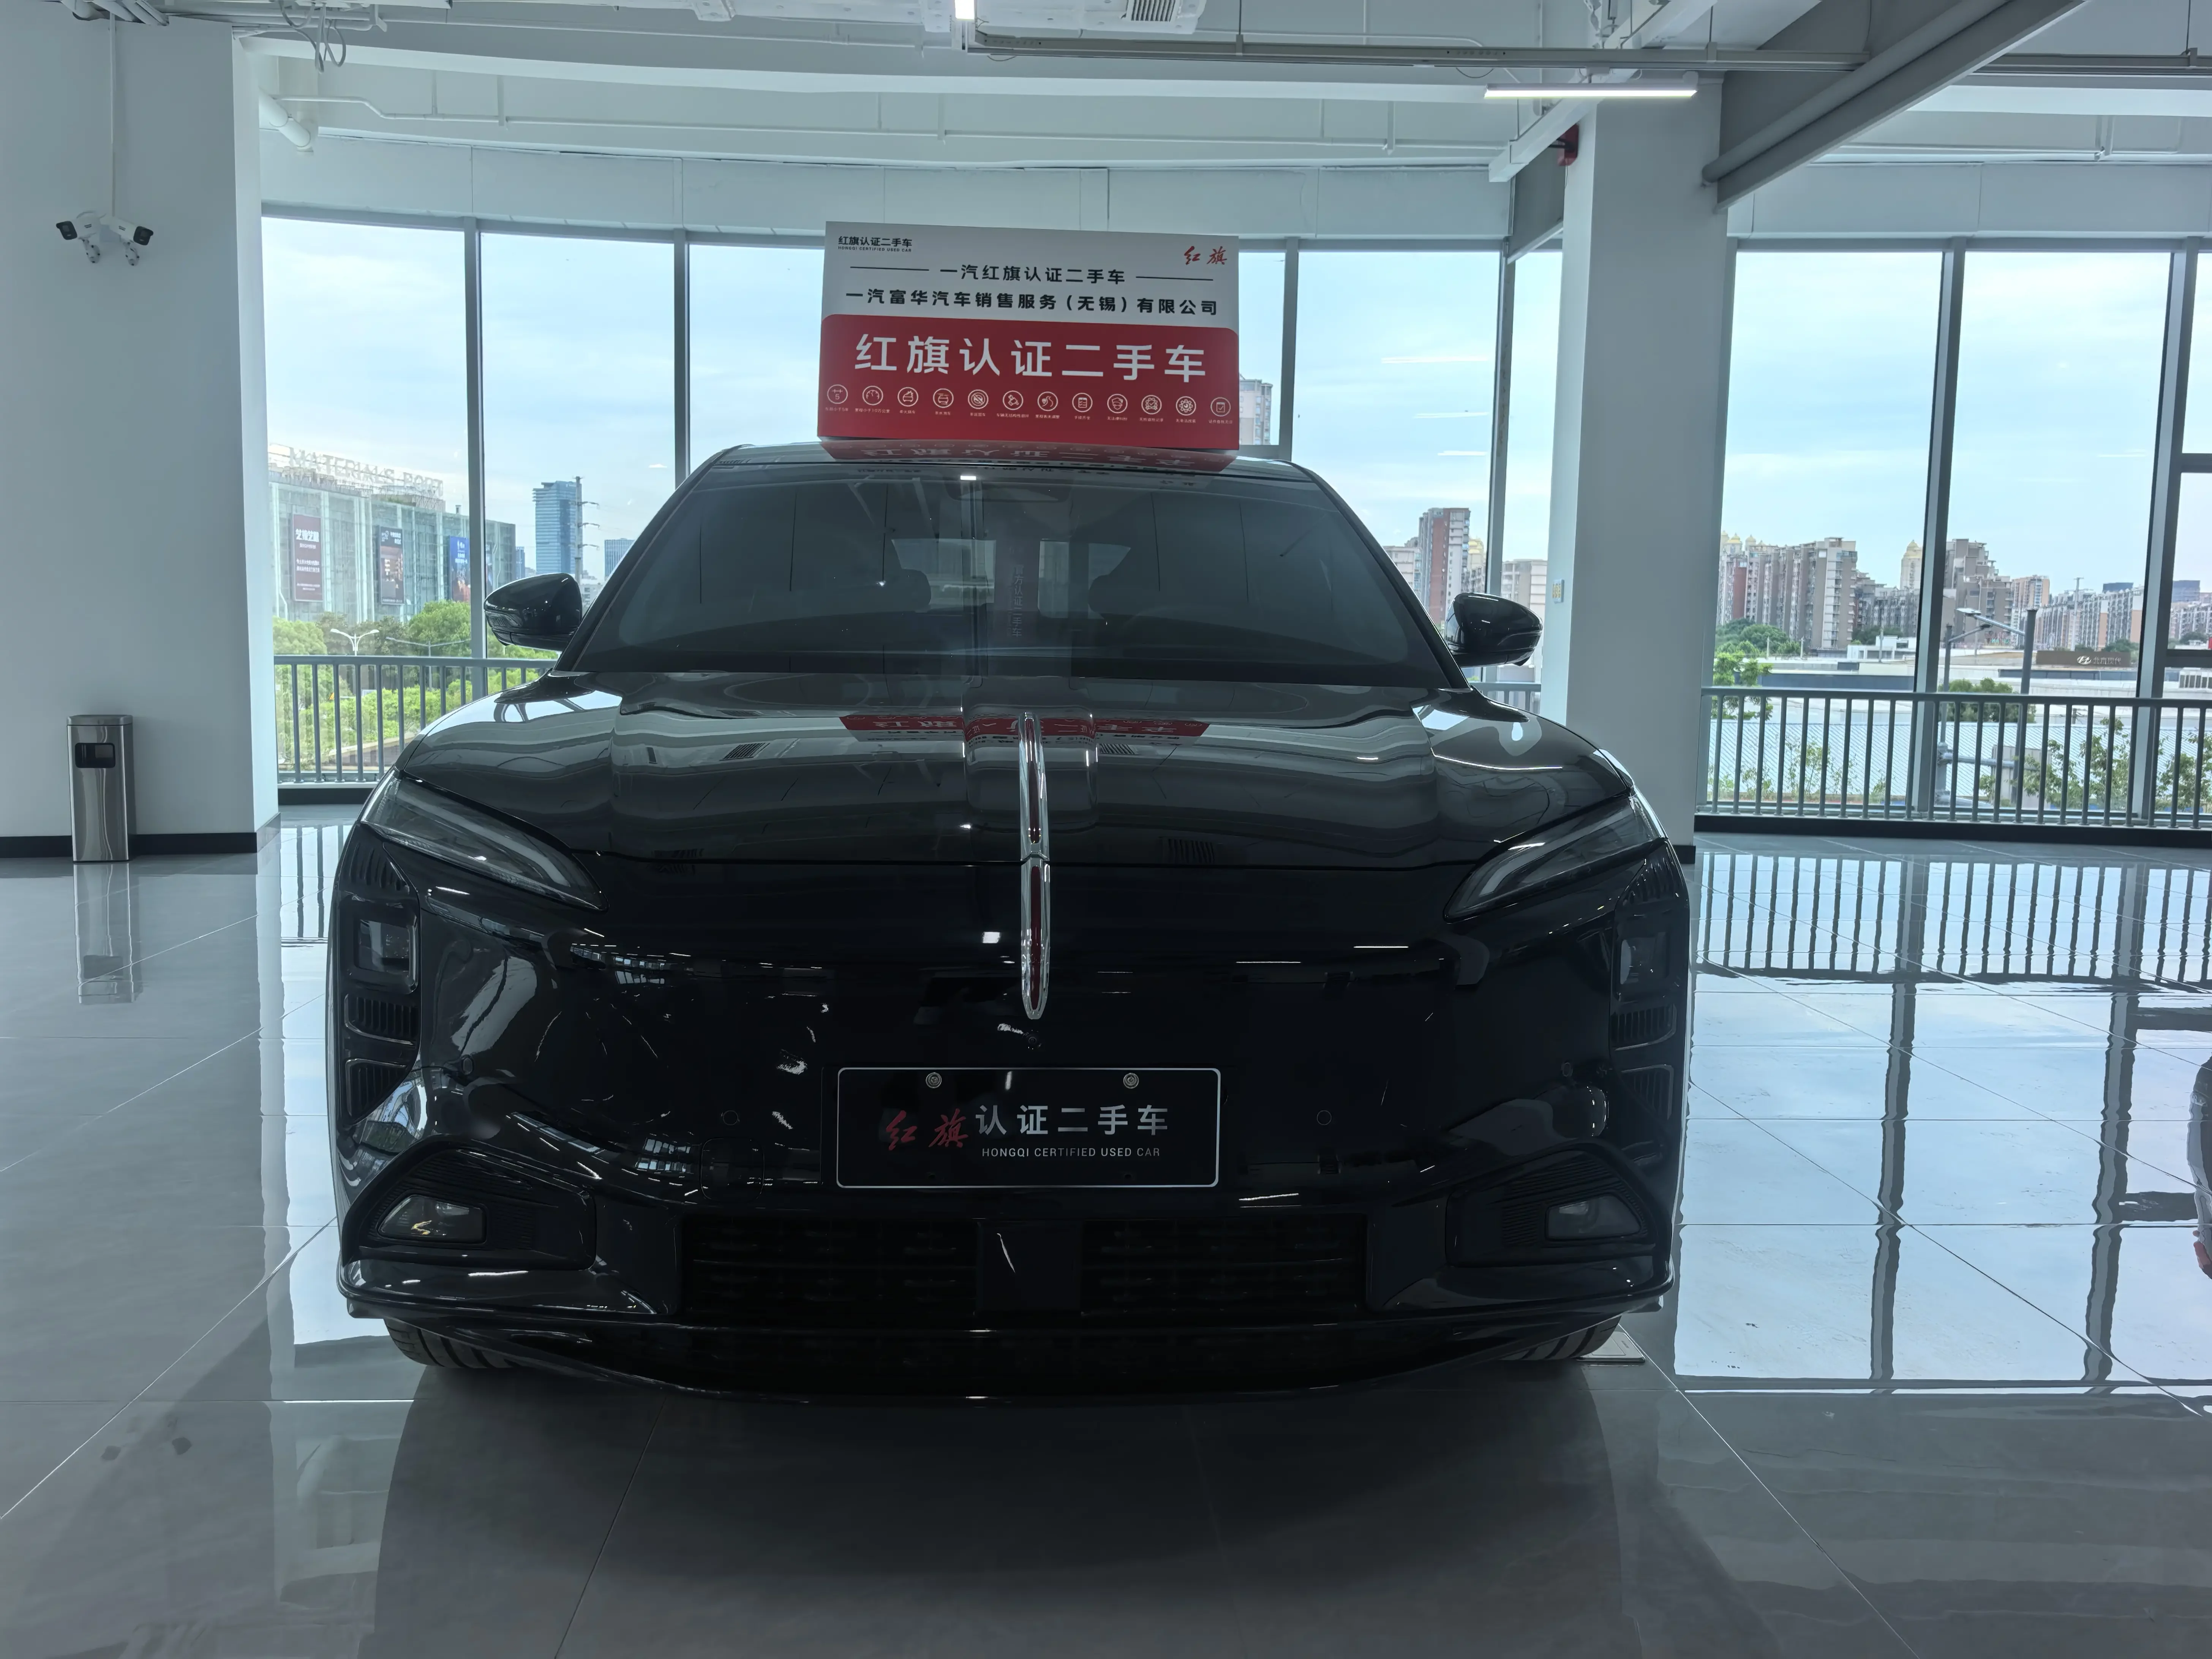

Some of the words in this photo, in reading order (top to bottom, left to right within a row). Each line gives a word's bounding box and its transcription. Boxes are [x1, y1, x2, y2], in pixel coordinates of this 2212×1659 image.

[838, 235, 913, 247] 红旗认证二手车
[1184, 245, 1228, 265] 红旗
[940, 264, 1126, 285] 一汽红旗认证二手车
[855, 333, 1206, 383] 红旗认证二手车
[982, 1148, 1029, 1157] HONGQI
[1034, 1148, 1096, 1157] CERTIFIED
[1101, 1148, 1132, 1157] USED
[1136, 1148, 1160, 1157] CAR
